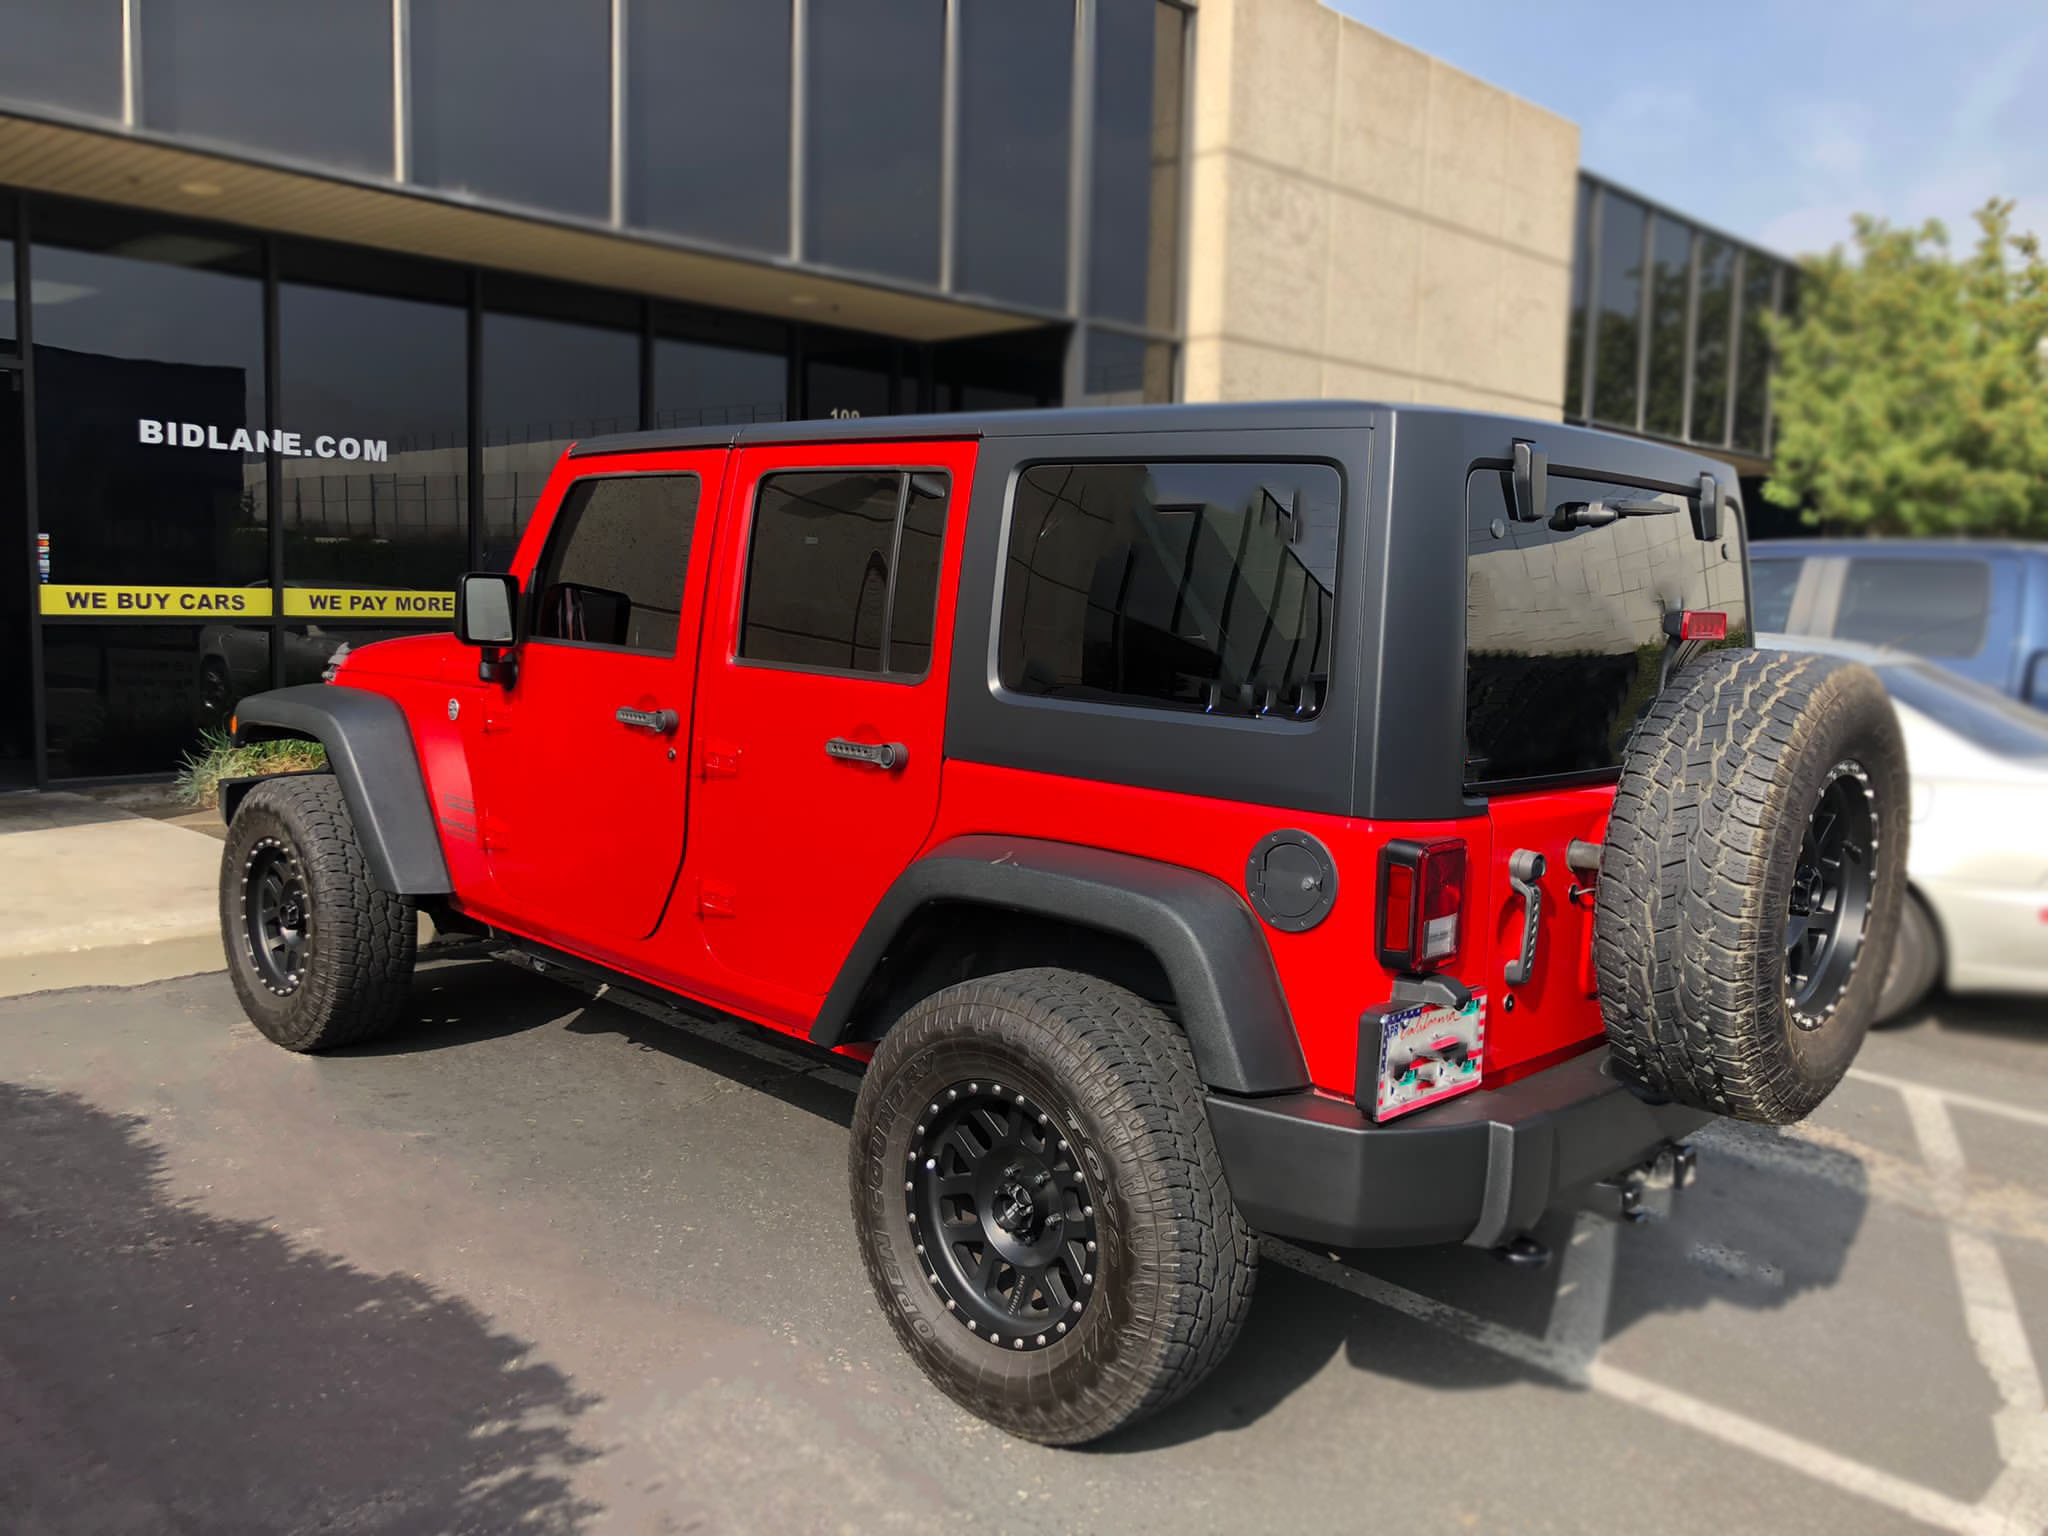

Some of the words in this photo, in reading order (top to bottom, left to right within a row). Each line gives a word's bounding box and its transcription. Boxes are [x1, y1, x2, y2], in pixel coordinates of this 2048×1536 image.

[138, 418, 388, 463] BIDLANE.COM
[66, 591, 108, 609] WE
[116, 592, 172, 610] BUY
[179, 593, 246, 611] CARS
[308, 594, 342, 611] WE
[350, 595, 388, 612] PAY
[395, 596, 454, 612] MORE
[1066, 1106, 1120, 1269] TOYO
[873, 1229, 935, 1341] OPEN
